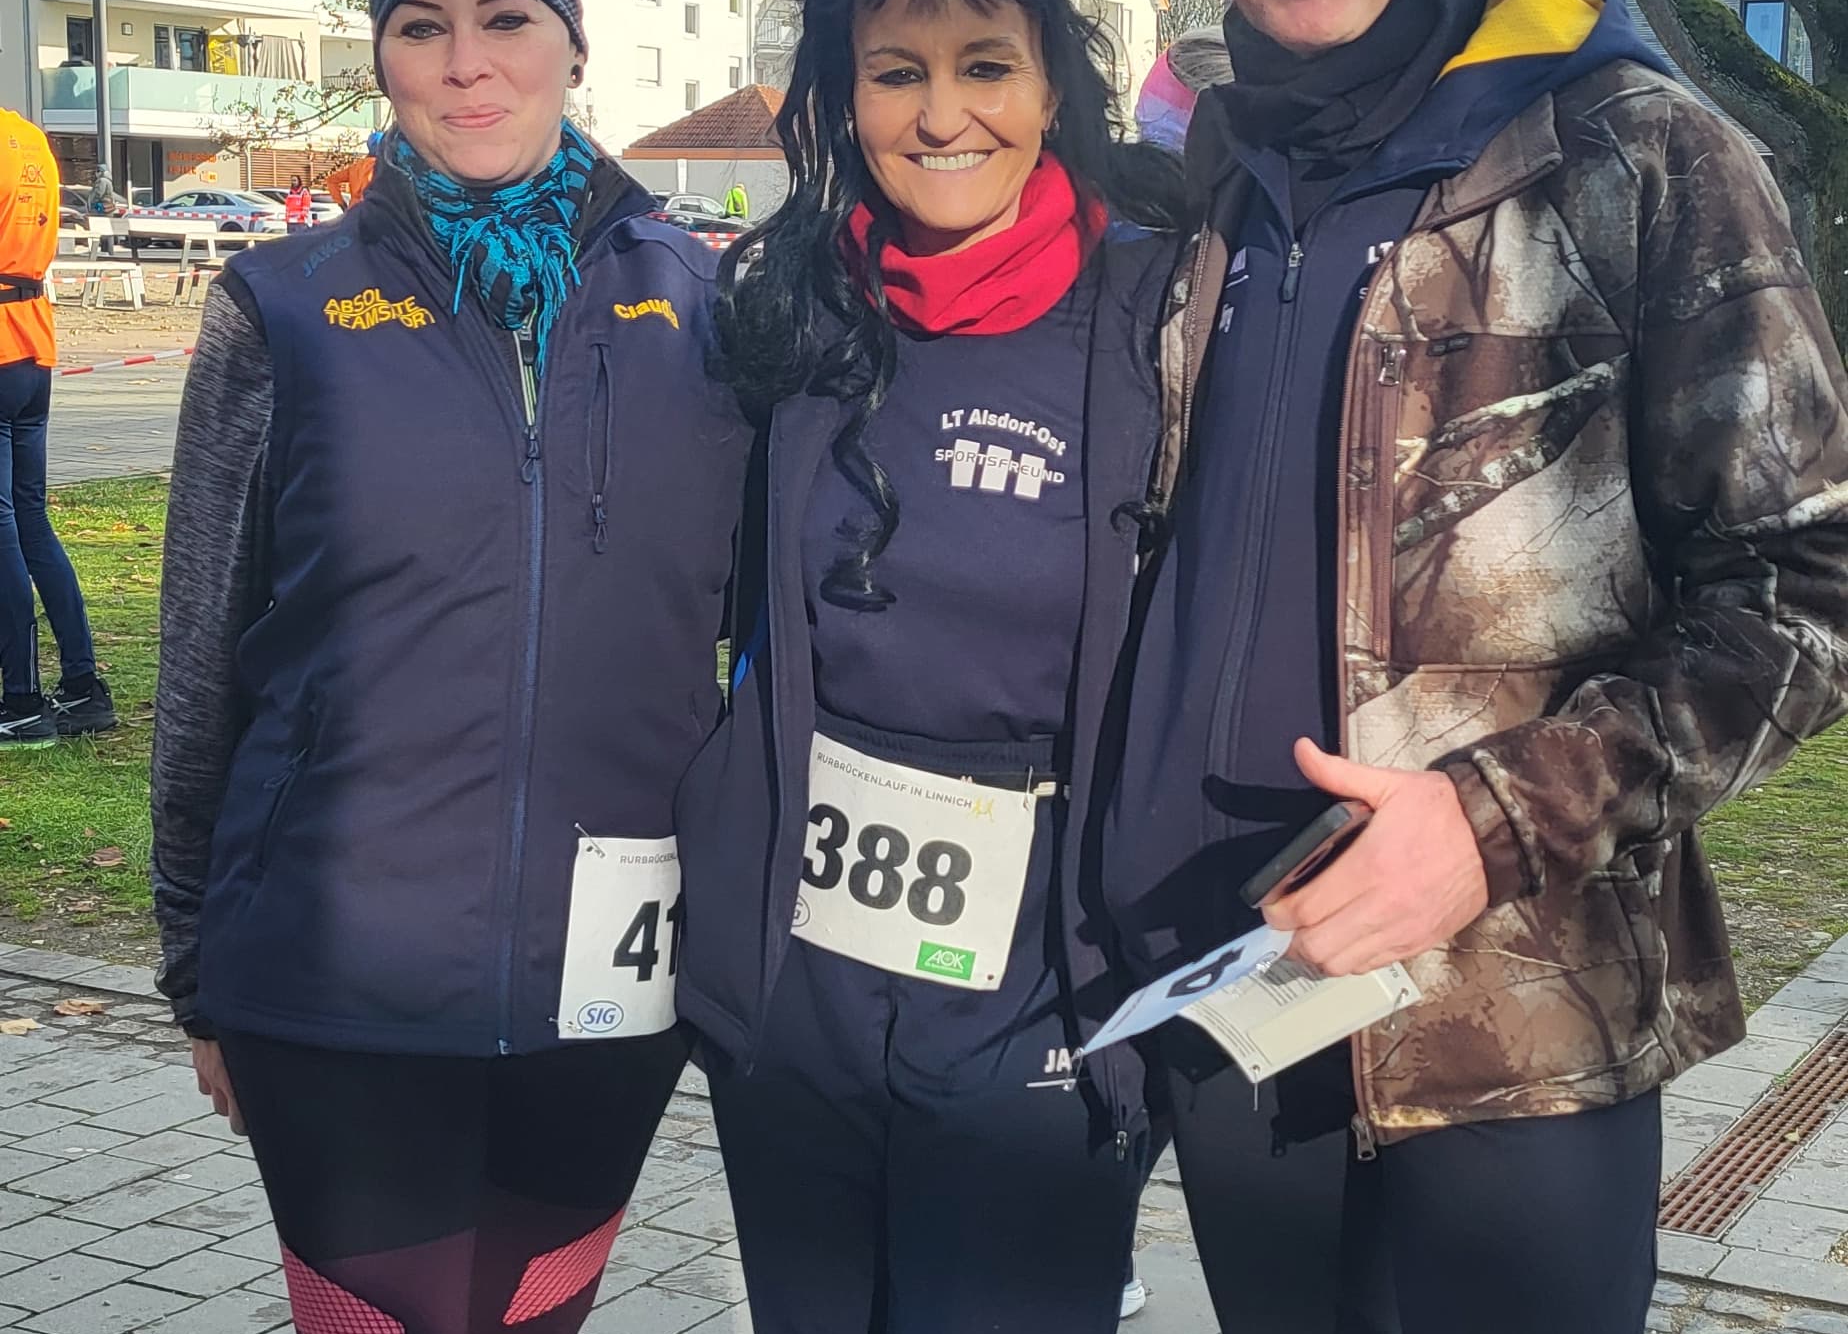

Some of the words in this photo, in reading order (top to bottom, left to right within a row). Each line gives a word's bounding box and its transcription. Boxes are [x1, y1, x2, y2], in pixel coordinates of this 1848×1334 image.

[19, 162, 46, 183] AOK
[303, 235, 353, 278] JAKO
[324, 288, 419, 315] ABSOLTE
[941, 409, 965, 430] LT
[967, 408, 1067, 456] Alsdorf-Ost
[934, 448, 1065, 484] SPORTSFREUND
[816, 751, 908, 793] RURBRÜCKENLAUF
[909, 785, 923, 798] IN
[925, 789, 973, 809] LINNICH
[801, 802, 972, 926] 388
[924, 949, 967, 970] AOK
[583, 1007, 617, 1026] SIG
